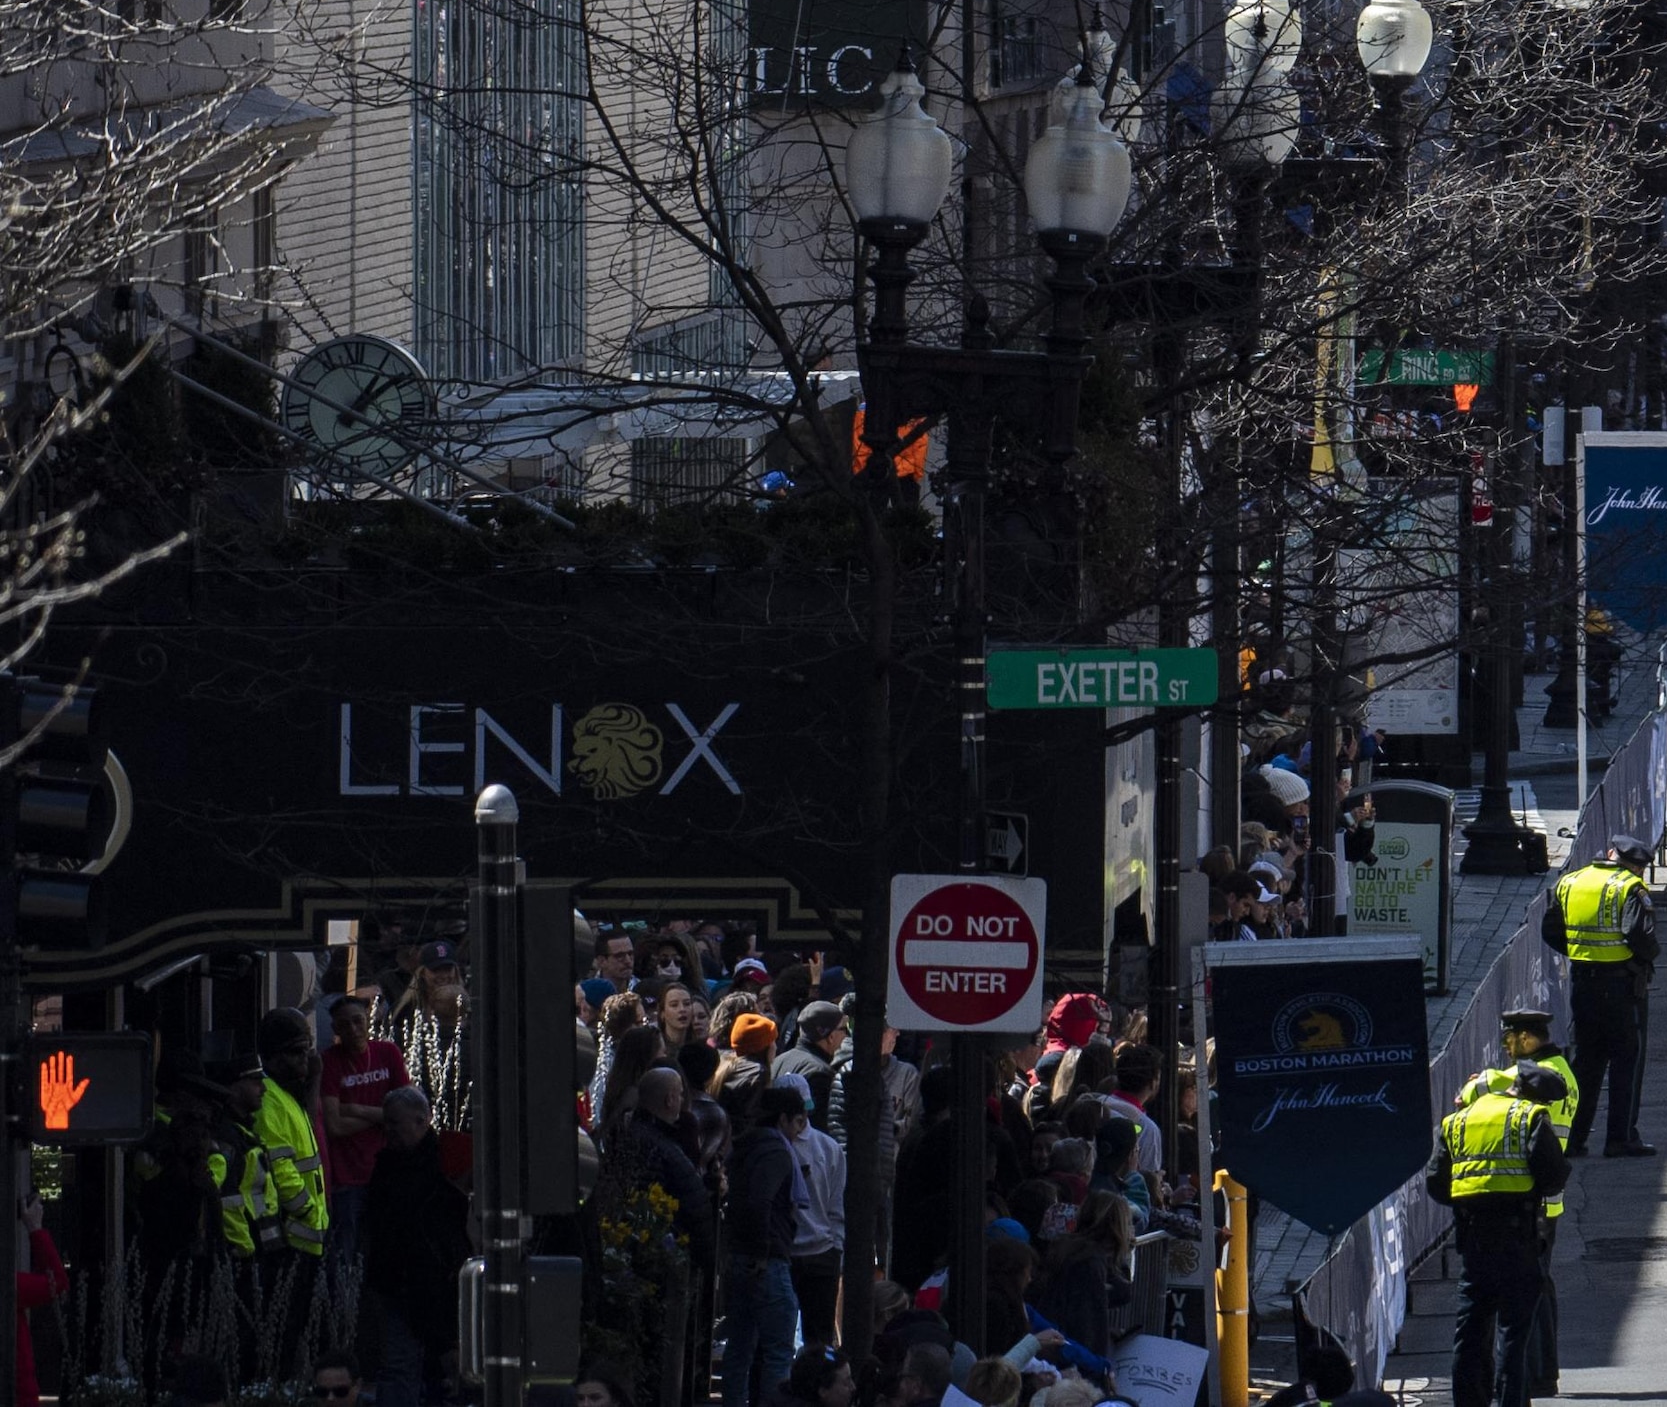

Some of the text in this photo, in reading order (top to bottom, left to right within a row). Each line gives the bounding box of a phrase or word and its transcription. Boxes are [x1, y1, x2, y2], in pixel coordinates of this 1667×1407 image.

[1402, 356, 1438, 382] RING
[1586, 487, 1640, 525] John
[1037, 661, 1189, 704] EXETER ST
[1355, 868, 1433, 881] DON'T LET
[1355, 881, 1416, 894] NATURE
[1354, 894, 1398, 907] GO TO
[916, 914, 1020, 937] DO NOT
[1354, 908, 1411, 923] WASTE.
[925, 972, 1006, 994] ENTER
[1234, 1048, 1414, 1074] BOSTON MARATHON
[1250, 1080, 1398, 1133] John Hancock
